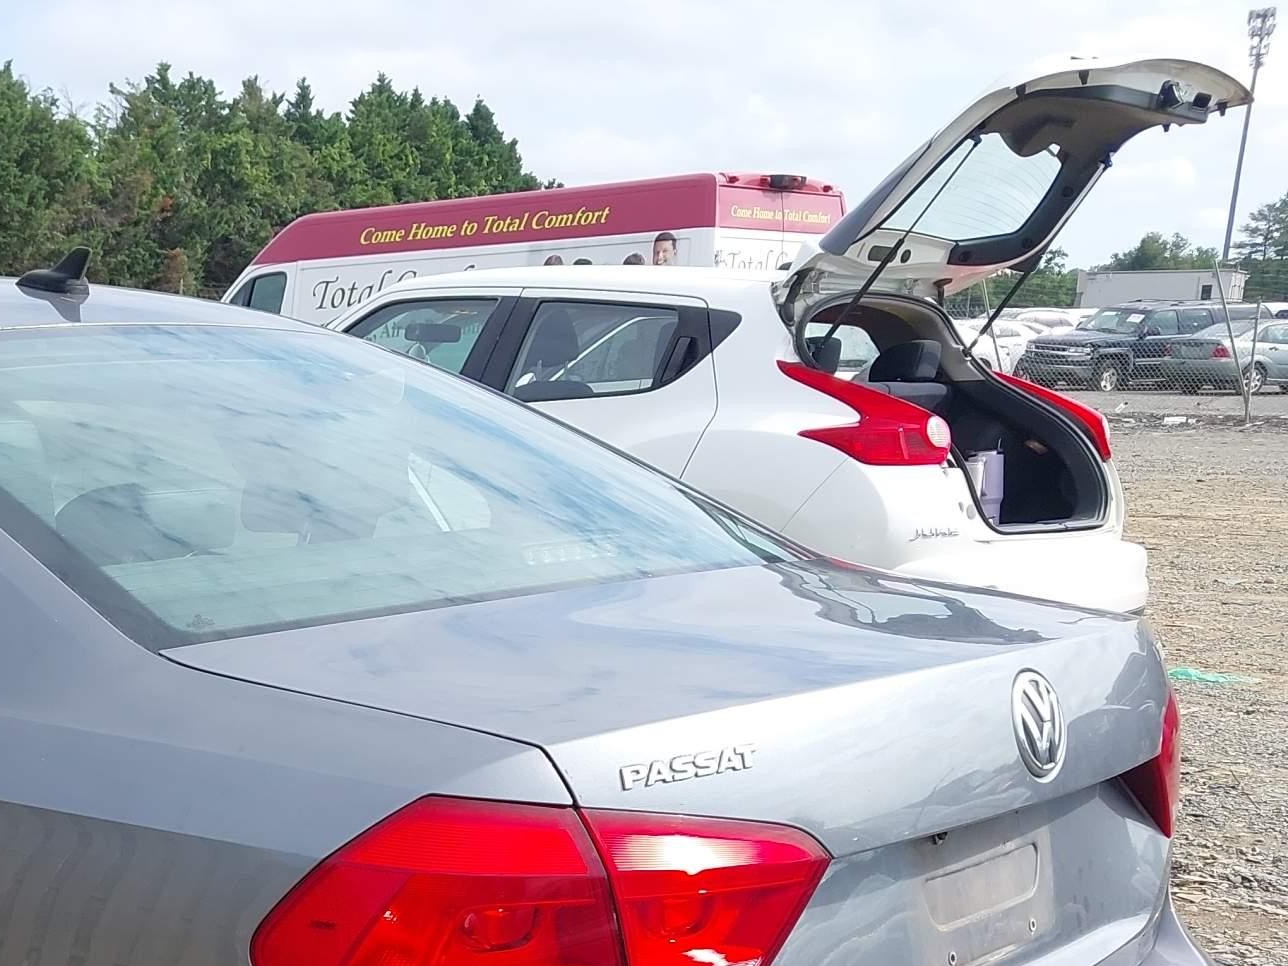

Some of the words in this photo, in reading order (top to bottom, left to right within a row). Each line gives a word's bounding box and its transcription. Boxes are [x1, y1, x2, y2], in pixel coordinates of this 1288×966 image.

[359, 227, 405, 245] Come
[406, 222, 457, 241] Home
[460, 219, 478, 236] to
[481, 212, 528, 235] Total
[531, 206, 610, 231] Comfort
[731, 204, 752, 218] Come
[752, 206, 774, 220] Home
[784, 209, 802, 222] Total
[802, 211, 831, 225] Comfort
[618, 743, 758, 791] PASSAT
